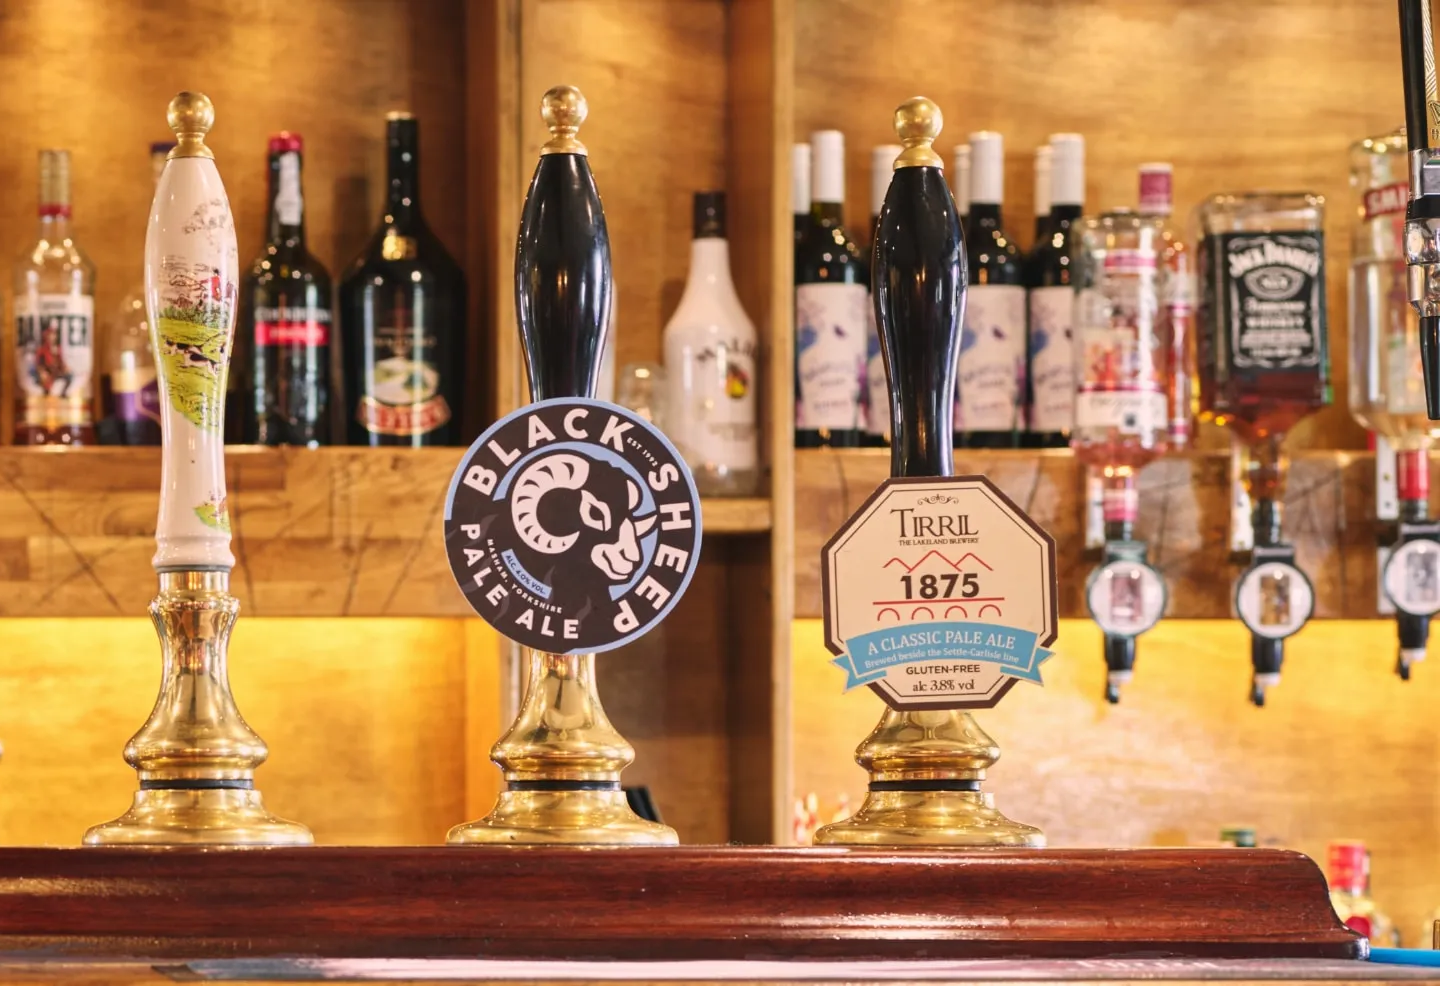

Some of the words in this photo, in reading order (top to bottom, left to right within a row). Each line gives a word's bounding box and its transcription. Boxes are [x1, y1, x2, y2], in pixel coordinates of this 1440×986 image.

[627, 437, 642, 450] EST
[642, 450, 658, 466] 1992
[463, 408, 634, 496] BLACK
[613, 463, 692, 633] SHEEP
[912, 538, 948, 546] LAKELAND
[949, 537, 979, 545] BREWERY
[460, 524, 509, 607] PALE
[515, 608, 579, 639] ALE
[900, 573, 980, 600] 1875
[511, 583, 563, 614] YORKSHIRE
[868, 641, 879, 656] A
[880, 631, 942, 652] CLASSIC
[945, 630, 983, 645] PALE
[986, 633, 1016, 650] ALE
[864, 653, 897, 669] Brewed
[898, 649, 926, 660] beside
[928, 648, 941, 656] the
[943, 647, 1001, 659] Settle-Carlisle
[1003, 652, 1019, 663] line
[906, 664, 981, 675] GLUTEN-FREE
[912, 680, 928, 692] alc
[930, 679, 955, 692] 3.8%
[958, 678, 975, 691] vol
